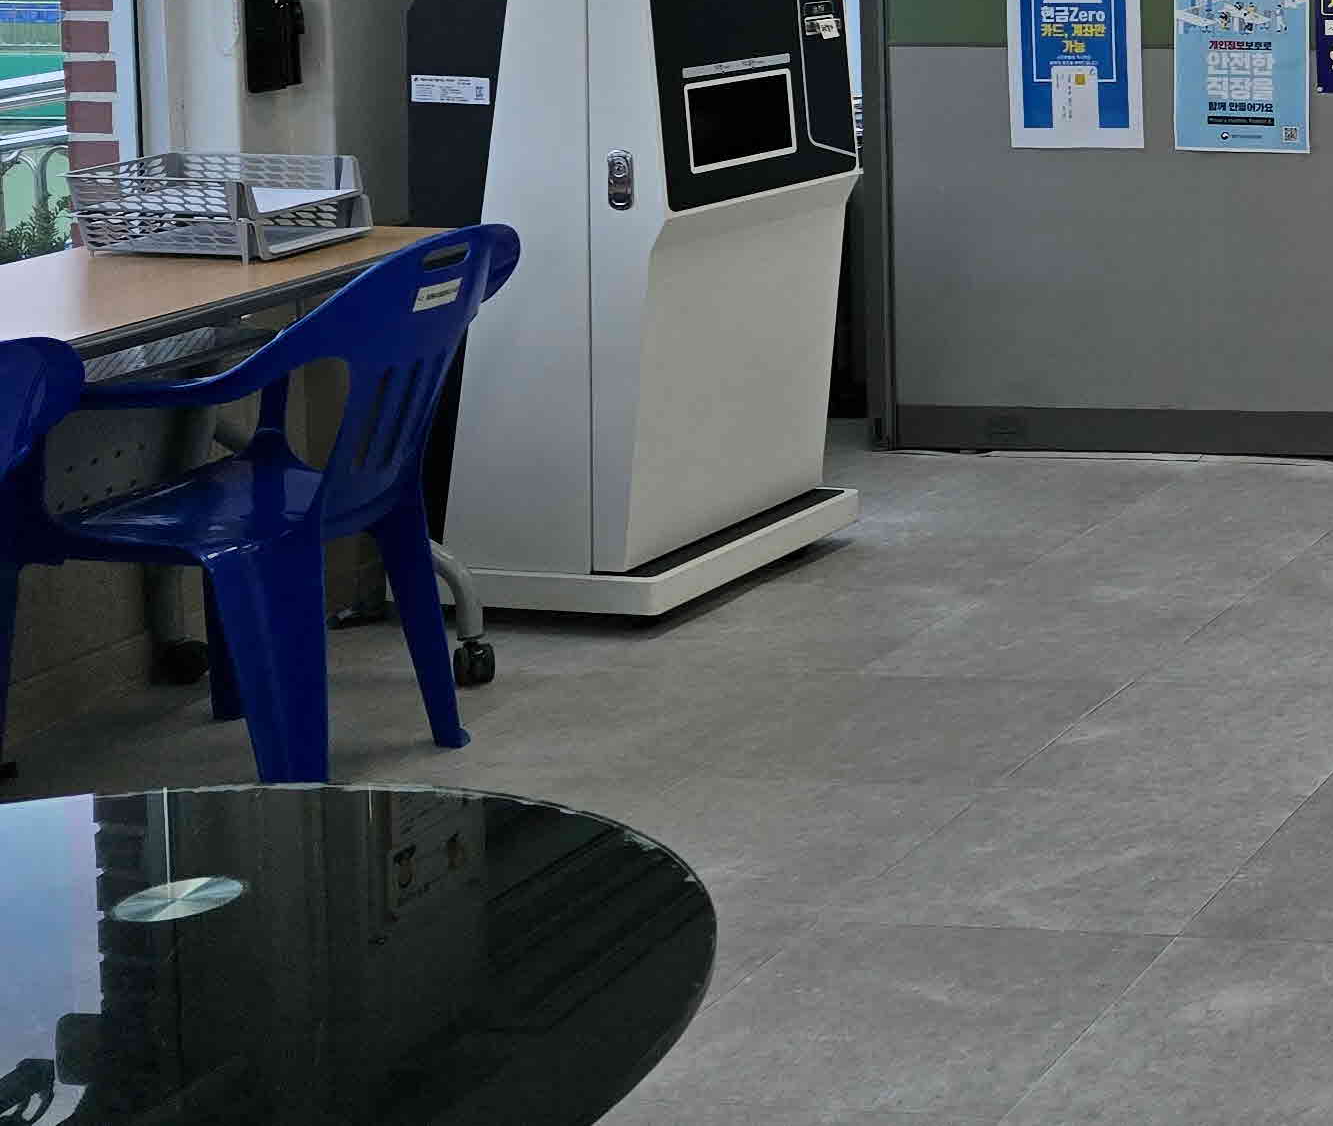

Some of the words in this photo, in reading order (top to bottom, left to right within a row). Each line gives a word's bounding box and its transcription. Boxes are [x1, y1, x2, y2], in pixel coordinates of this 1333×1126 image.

[1040, 6, 1106, 23] 현금Zero
[1062, 41, 1086, 53] 가능
[1208, 40, 1273, 51] 개인정보보호로
[1229, 101, 1274, 113] 만들어가요
